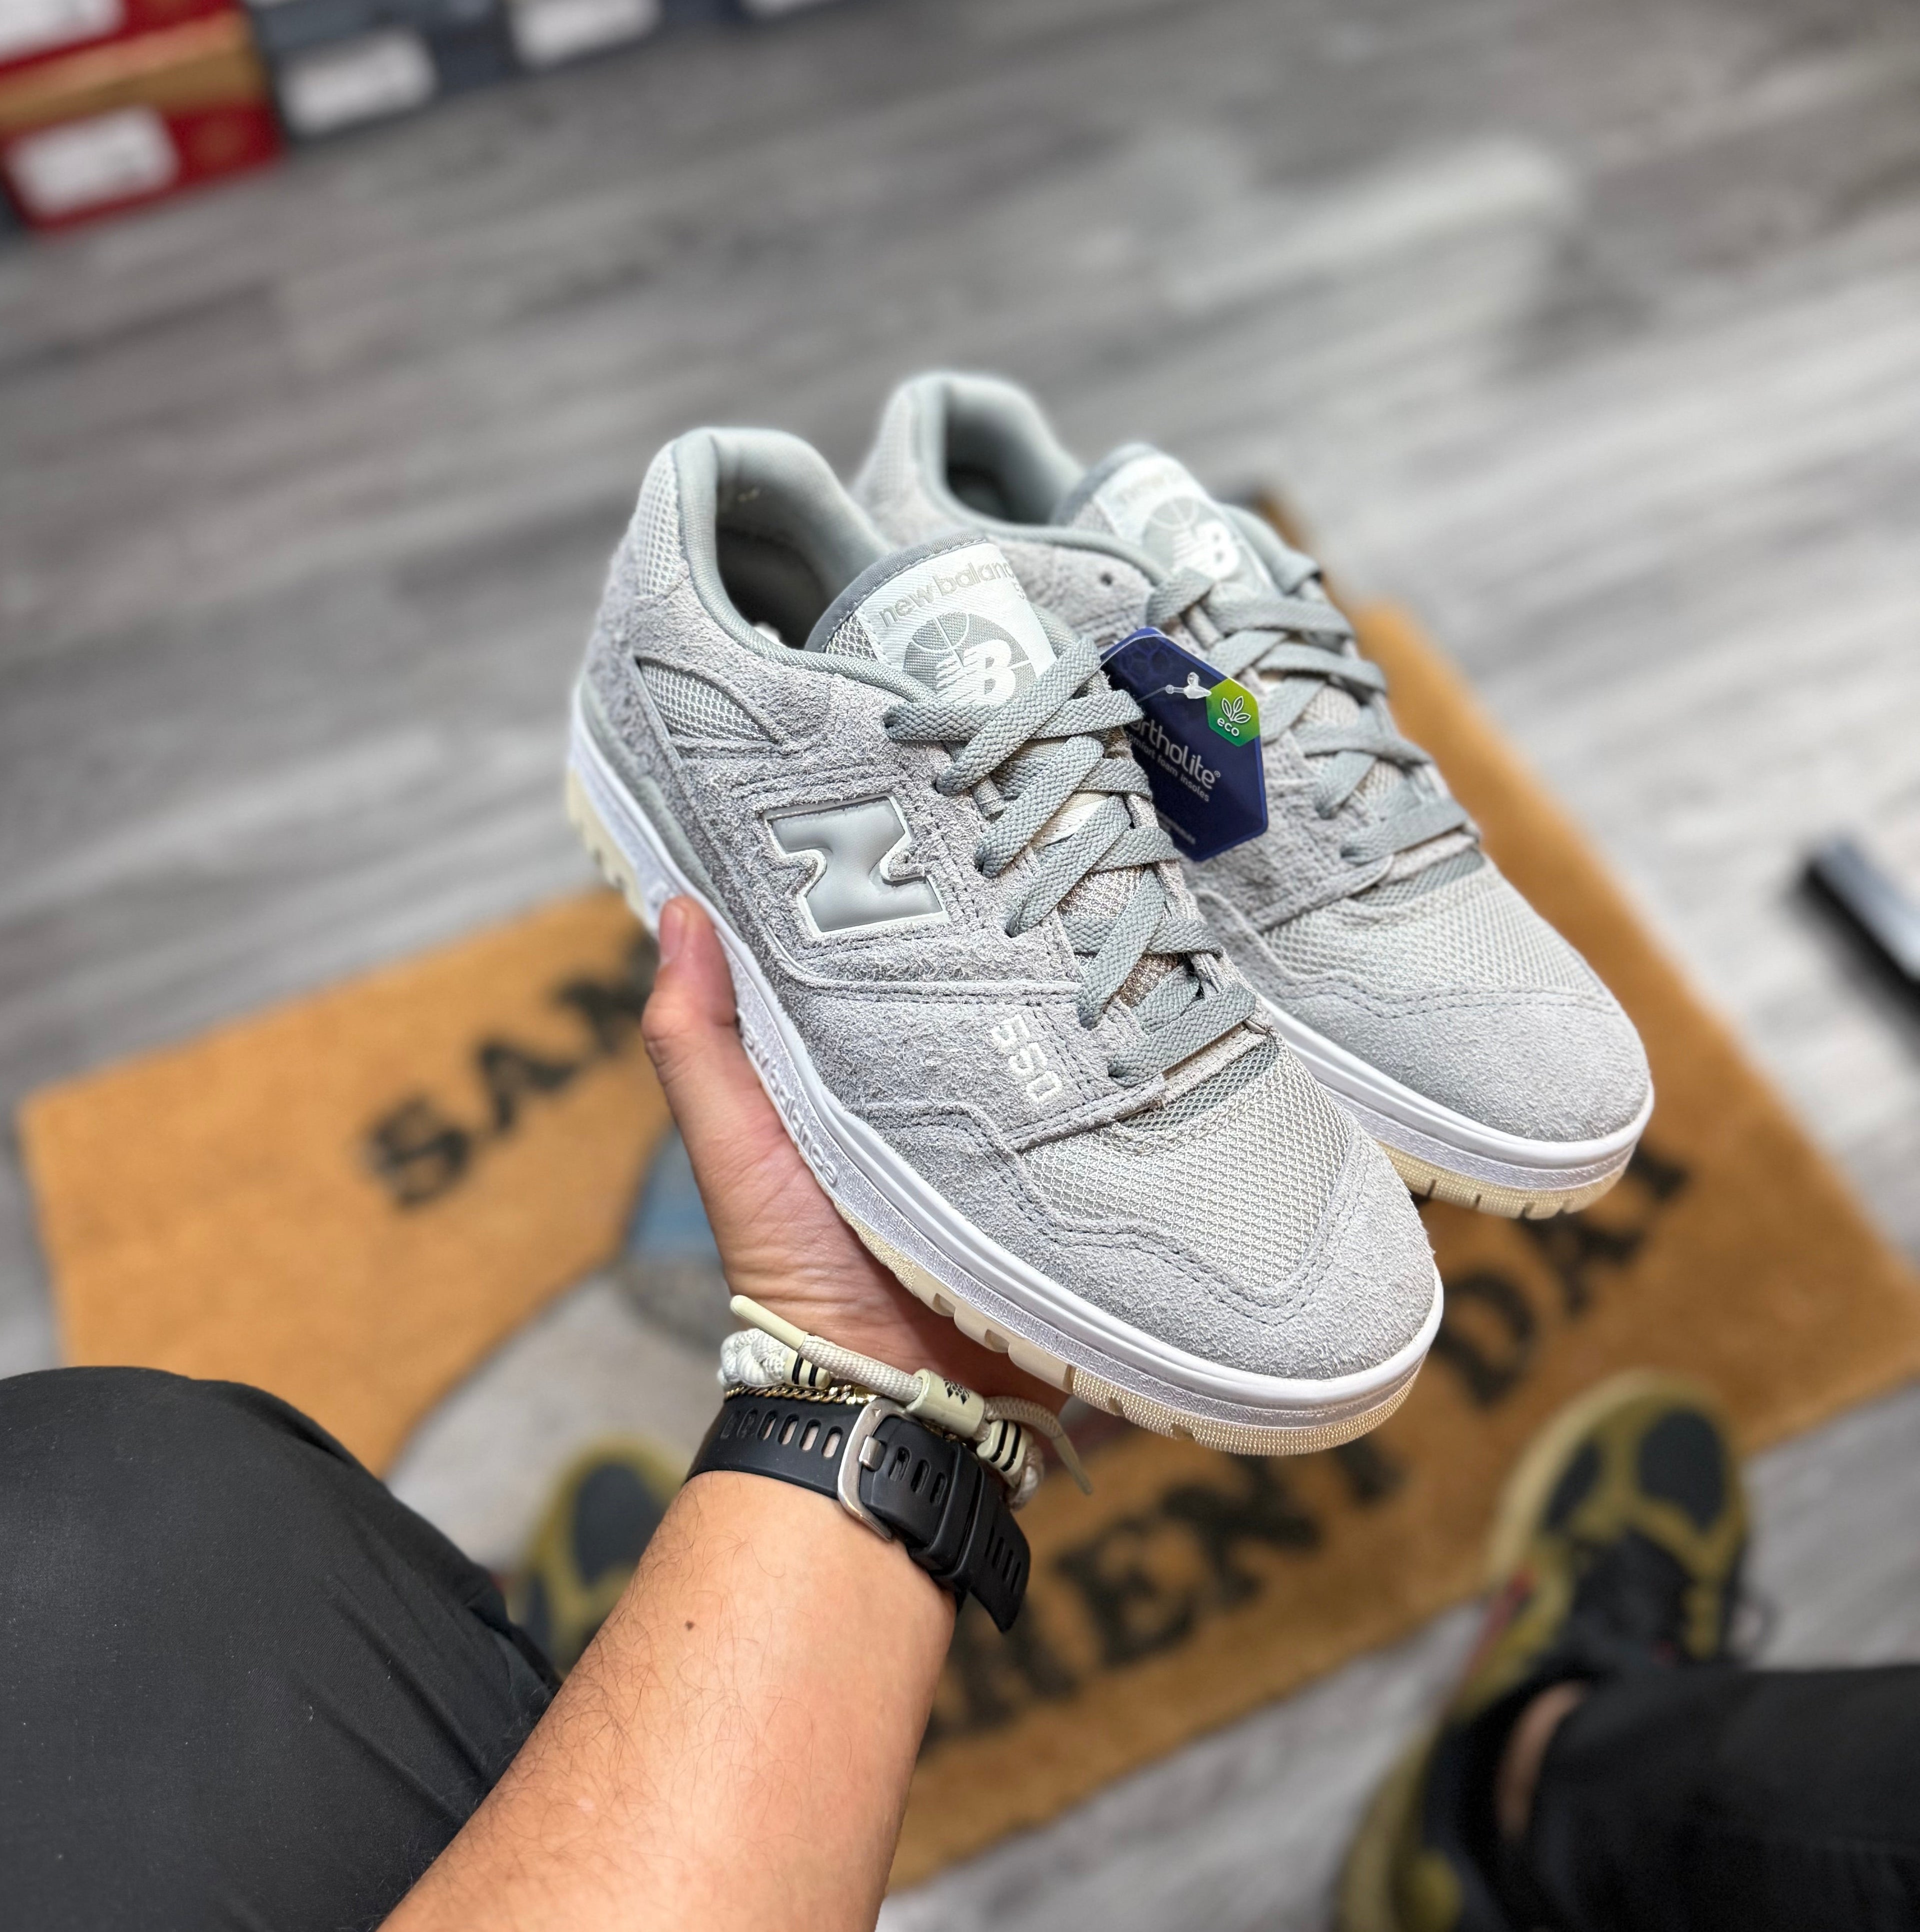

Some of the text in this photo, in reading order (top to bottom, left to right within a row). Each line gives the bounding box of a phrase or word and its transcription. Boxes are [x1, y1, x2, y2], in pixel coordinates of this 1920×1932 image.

[878, 583, 934, 628] new
[1217, 717, 1240, 737] eco
[1126, 731, 1210, 802] omfort foam insoles
[992, 1013, 1063, 1101] 550
